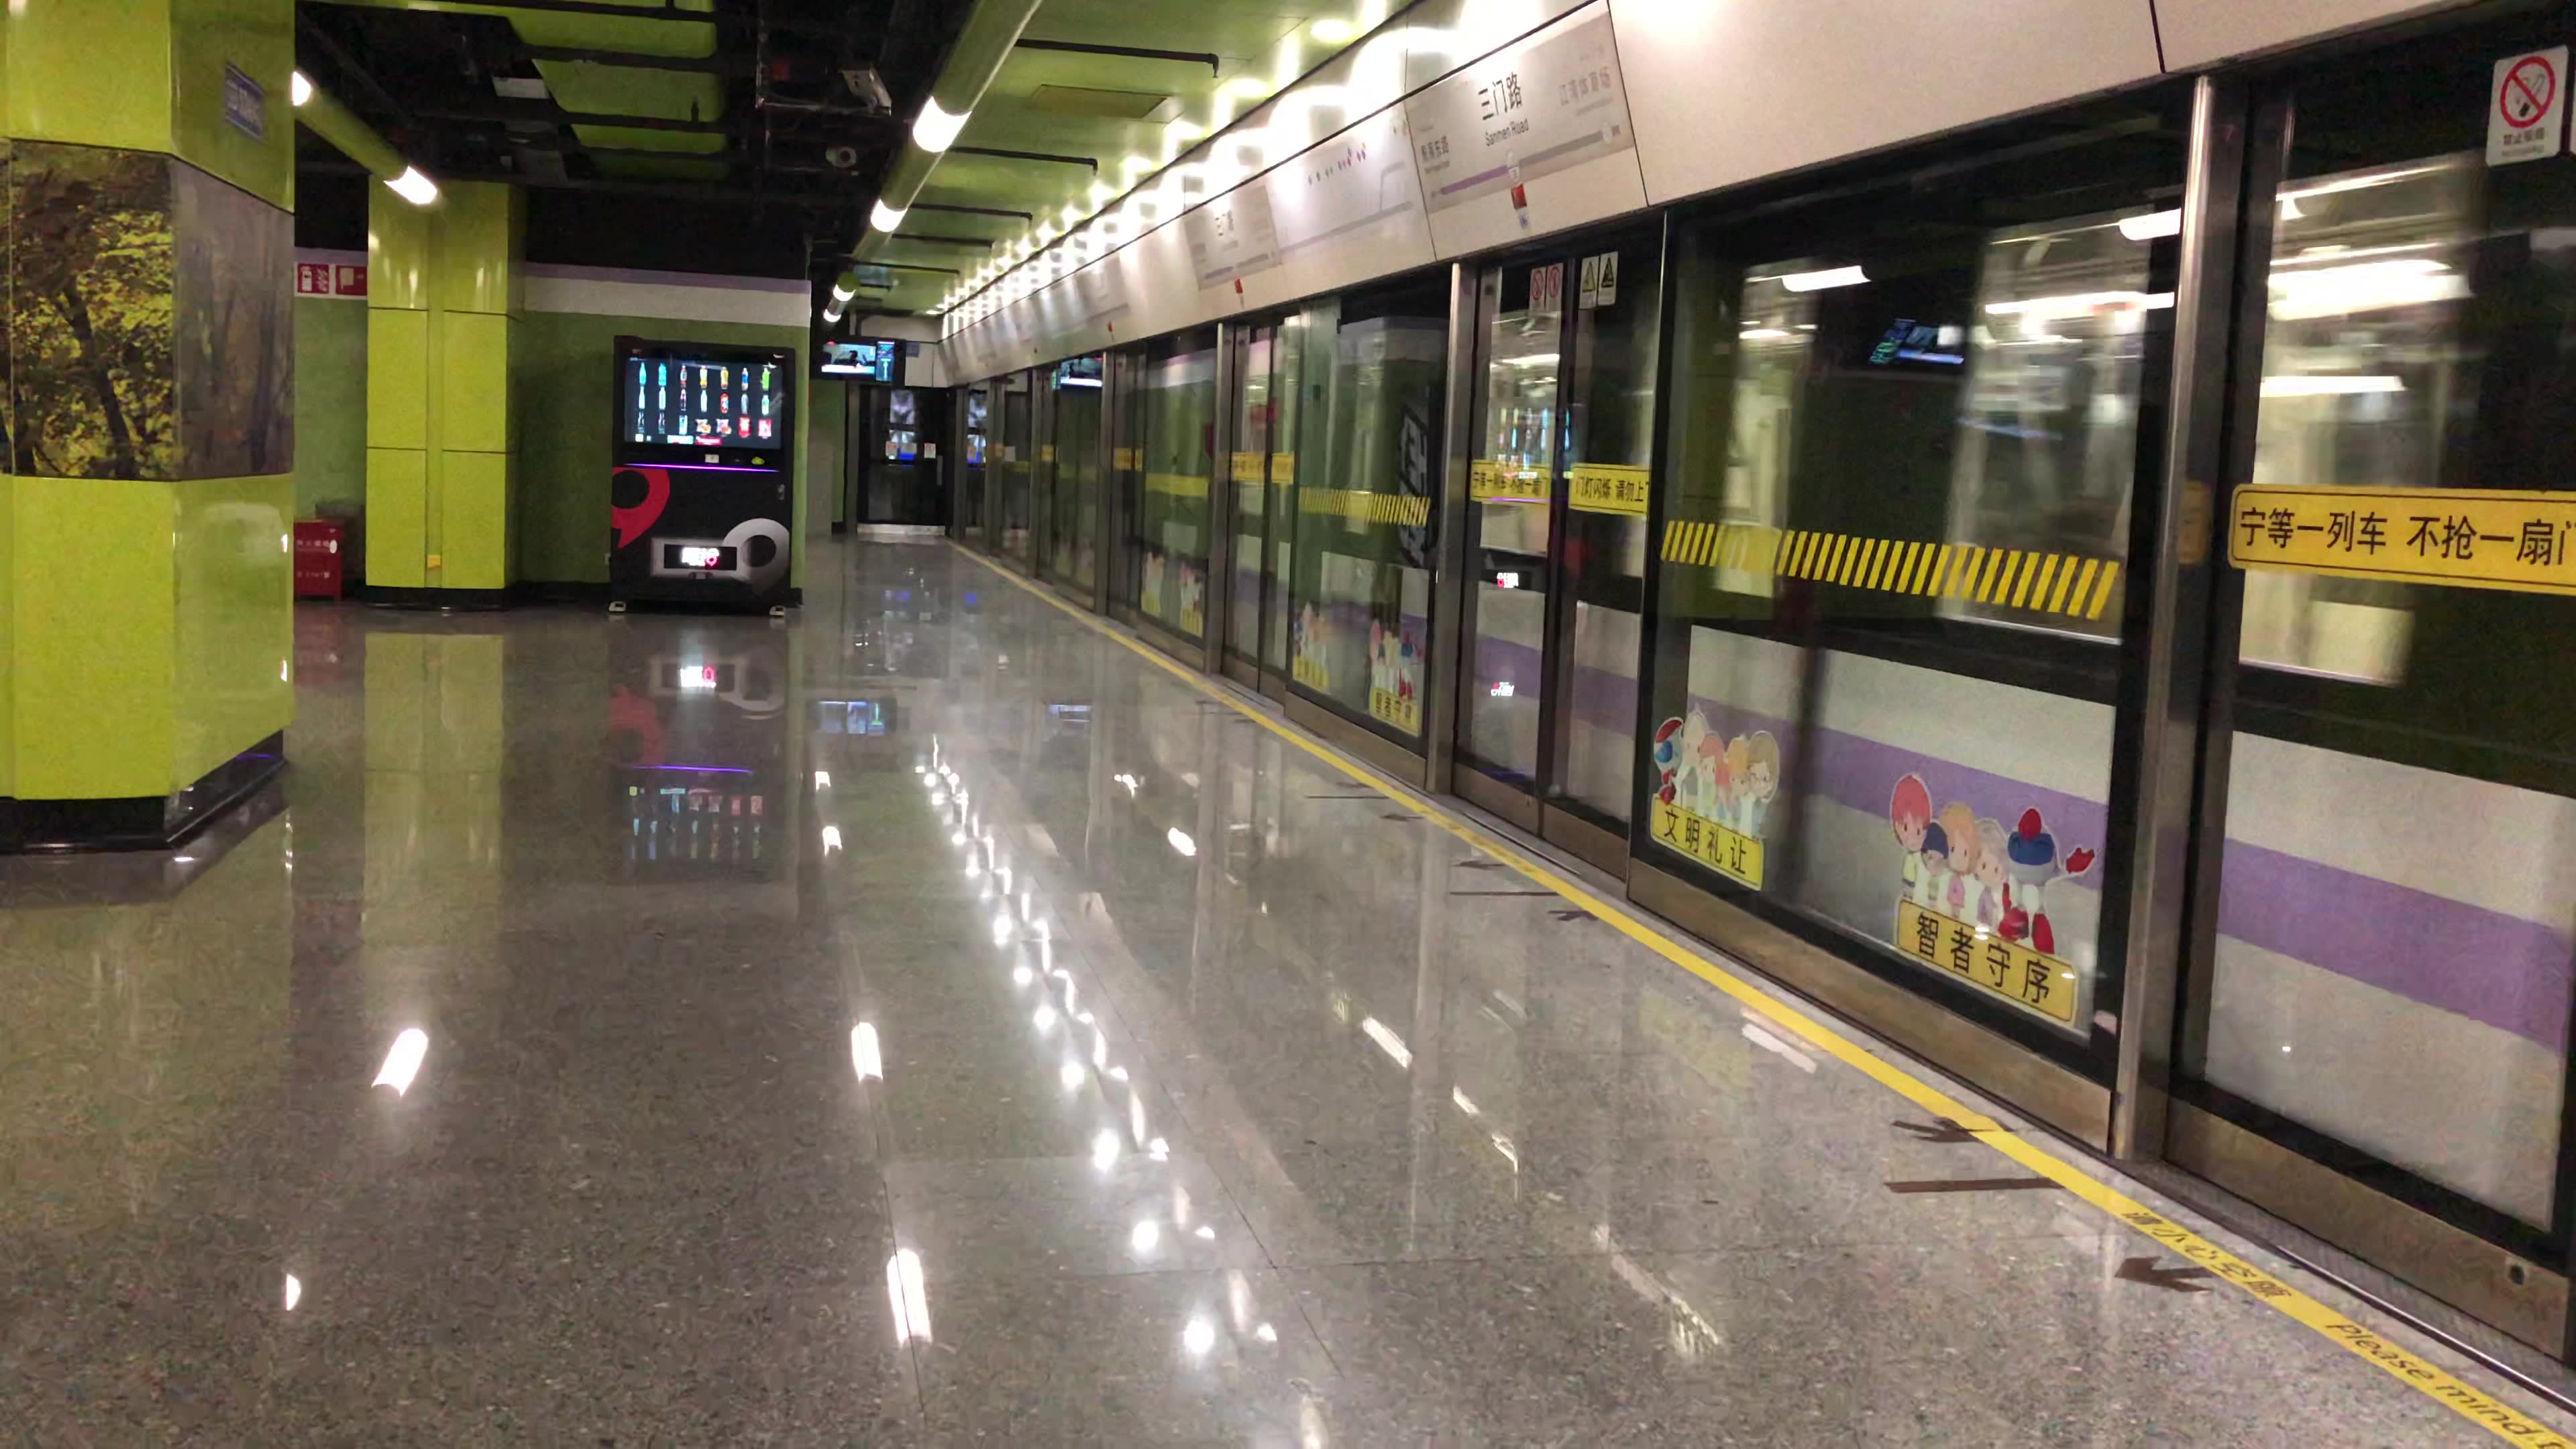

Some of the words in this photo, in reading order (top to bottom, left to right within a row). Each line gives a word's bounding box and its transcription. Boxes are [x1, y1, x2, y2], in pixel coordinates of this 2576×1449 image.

[1478, 72, 1523, 121] 三门路
[1509, 117, 1529, 136] Road
[1615, 478, 1649, 502] 请勿上
[2240, 506, 2388, 555] 宁等一列车
[1664, 807, 1747, 875] 文明礼让
[1916, 912, 2051, 1004] 智者守序
[2325, 1324, 2435, 1380] Please
[2435, 1385, 2544, 1435] mind
